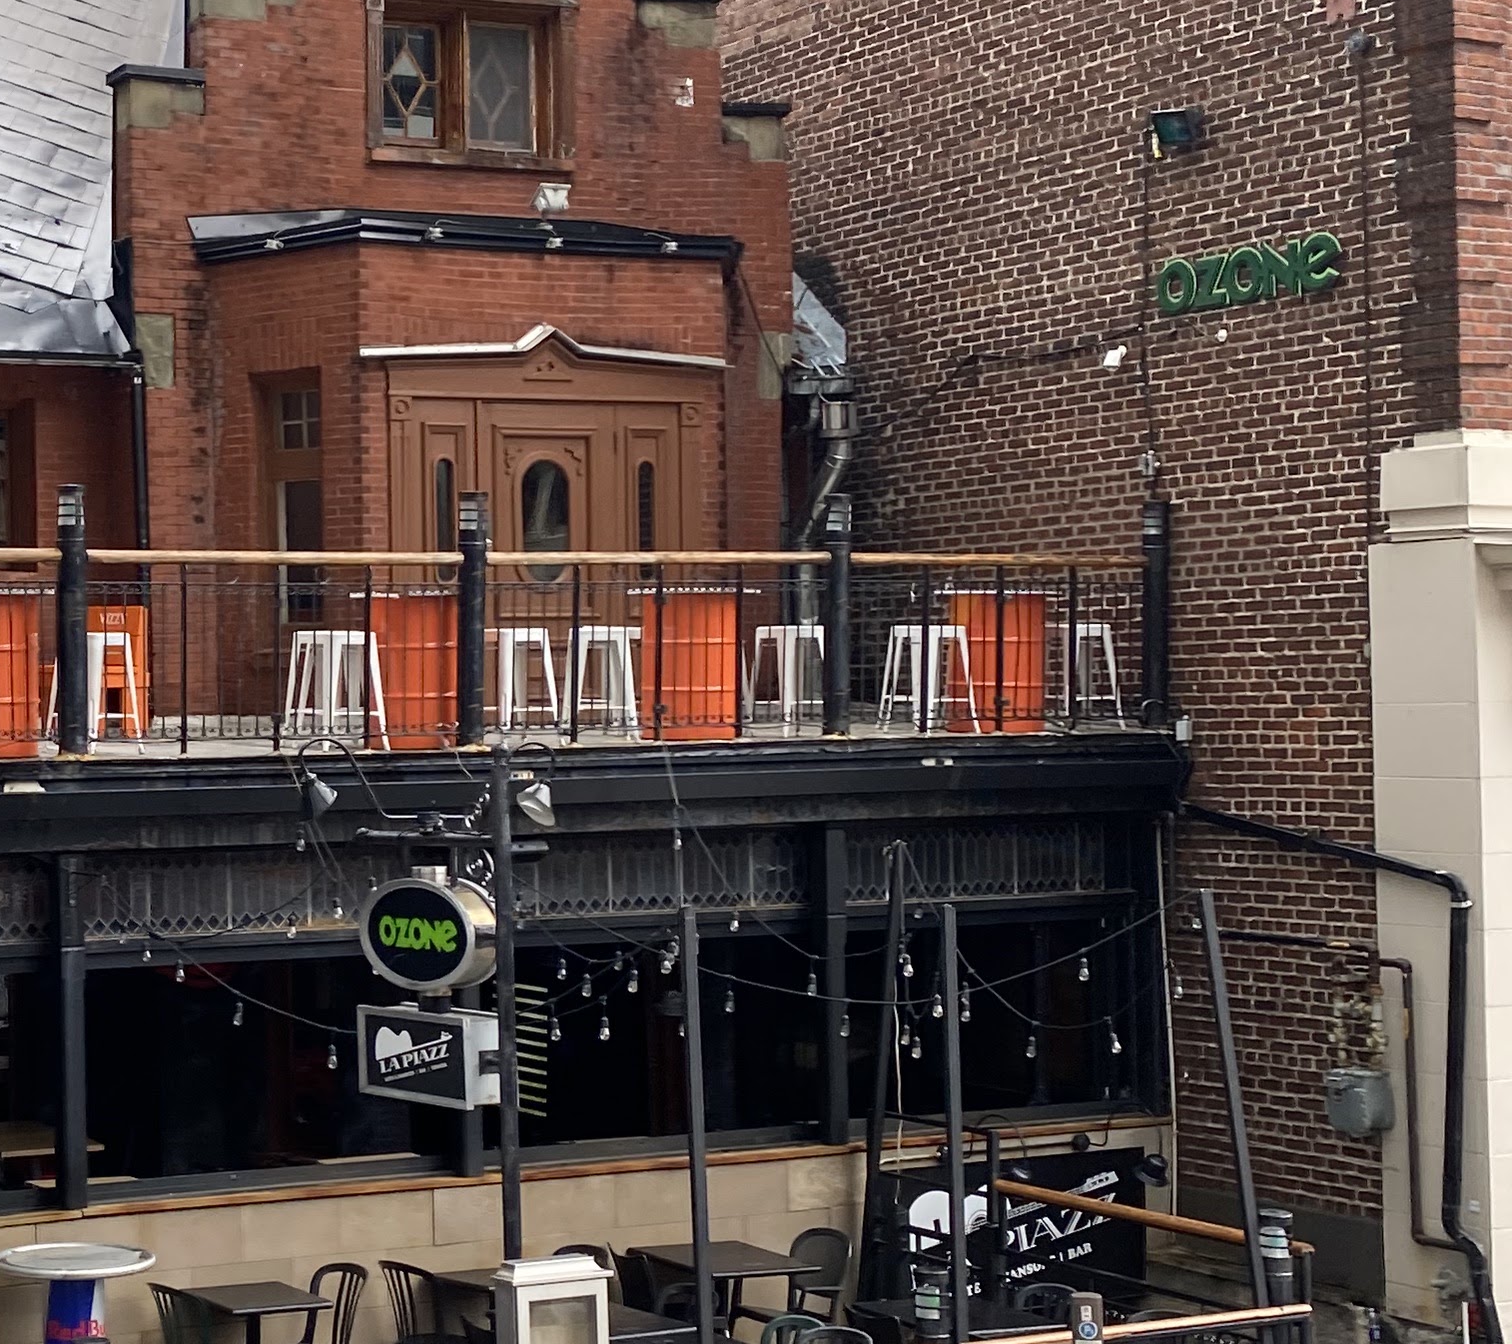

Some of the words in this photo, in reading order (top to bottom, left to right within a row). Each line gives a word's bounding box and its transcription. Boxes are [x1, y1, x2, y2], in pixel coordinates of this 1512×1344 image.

[378, 1056, 402, 1074] LA
[401, 1043, 450, 1069] PIAZZ
[1067, 1242, 1093, 1260] BAR
